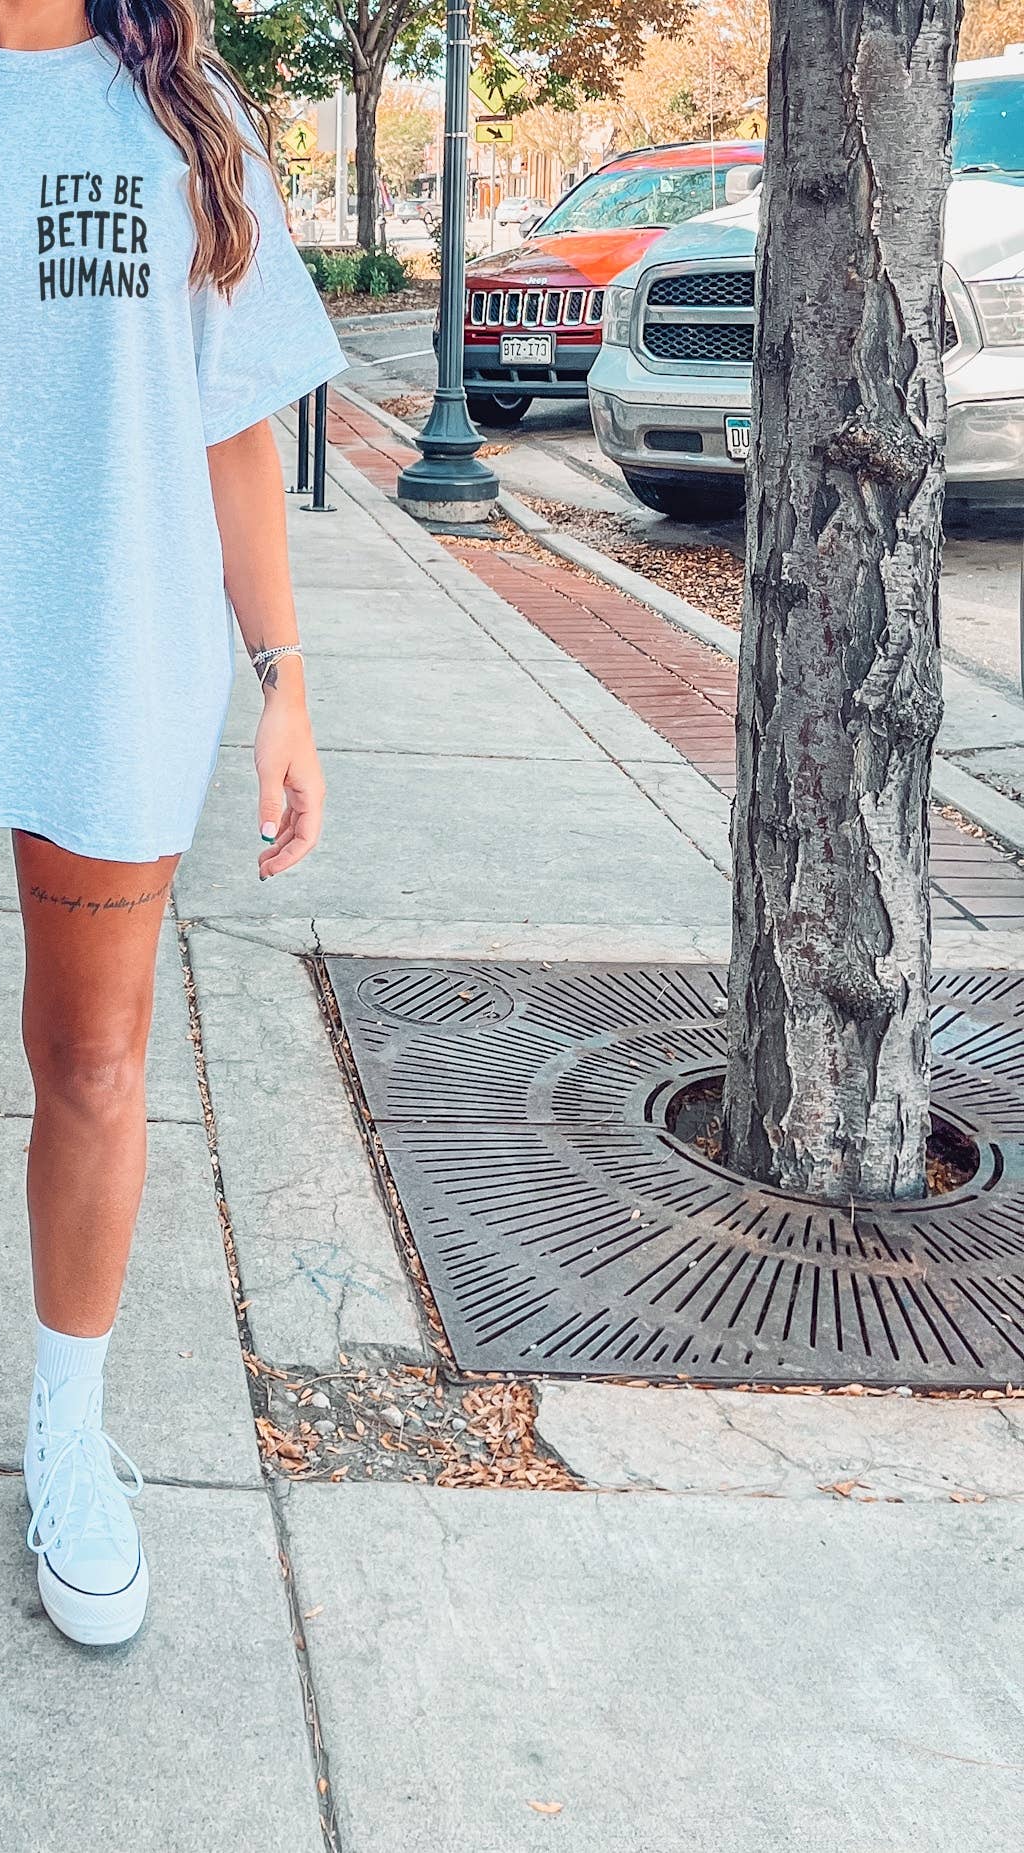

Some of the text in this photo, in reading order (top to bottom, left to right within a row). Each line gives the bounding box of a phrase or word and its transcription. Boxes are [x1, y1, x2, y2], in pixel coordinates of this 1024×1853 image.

[40, 171, 144, 209] LET'S BE
[37, 210, 148, 255] BETTER
[39, 256, 151, 302] HUMANS
[525, 276, 548, 285] Jeep
[731, 428, 750, 448] DU
[87, 902, 101, 917] my
